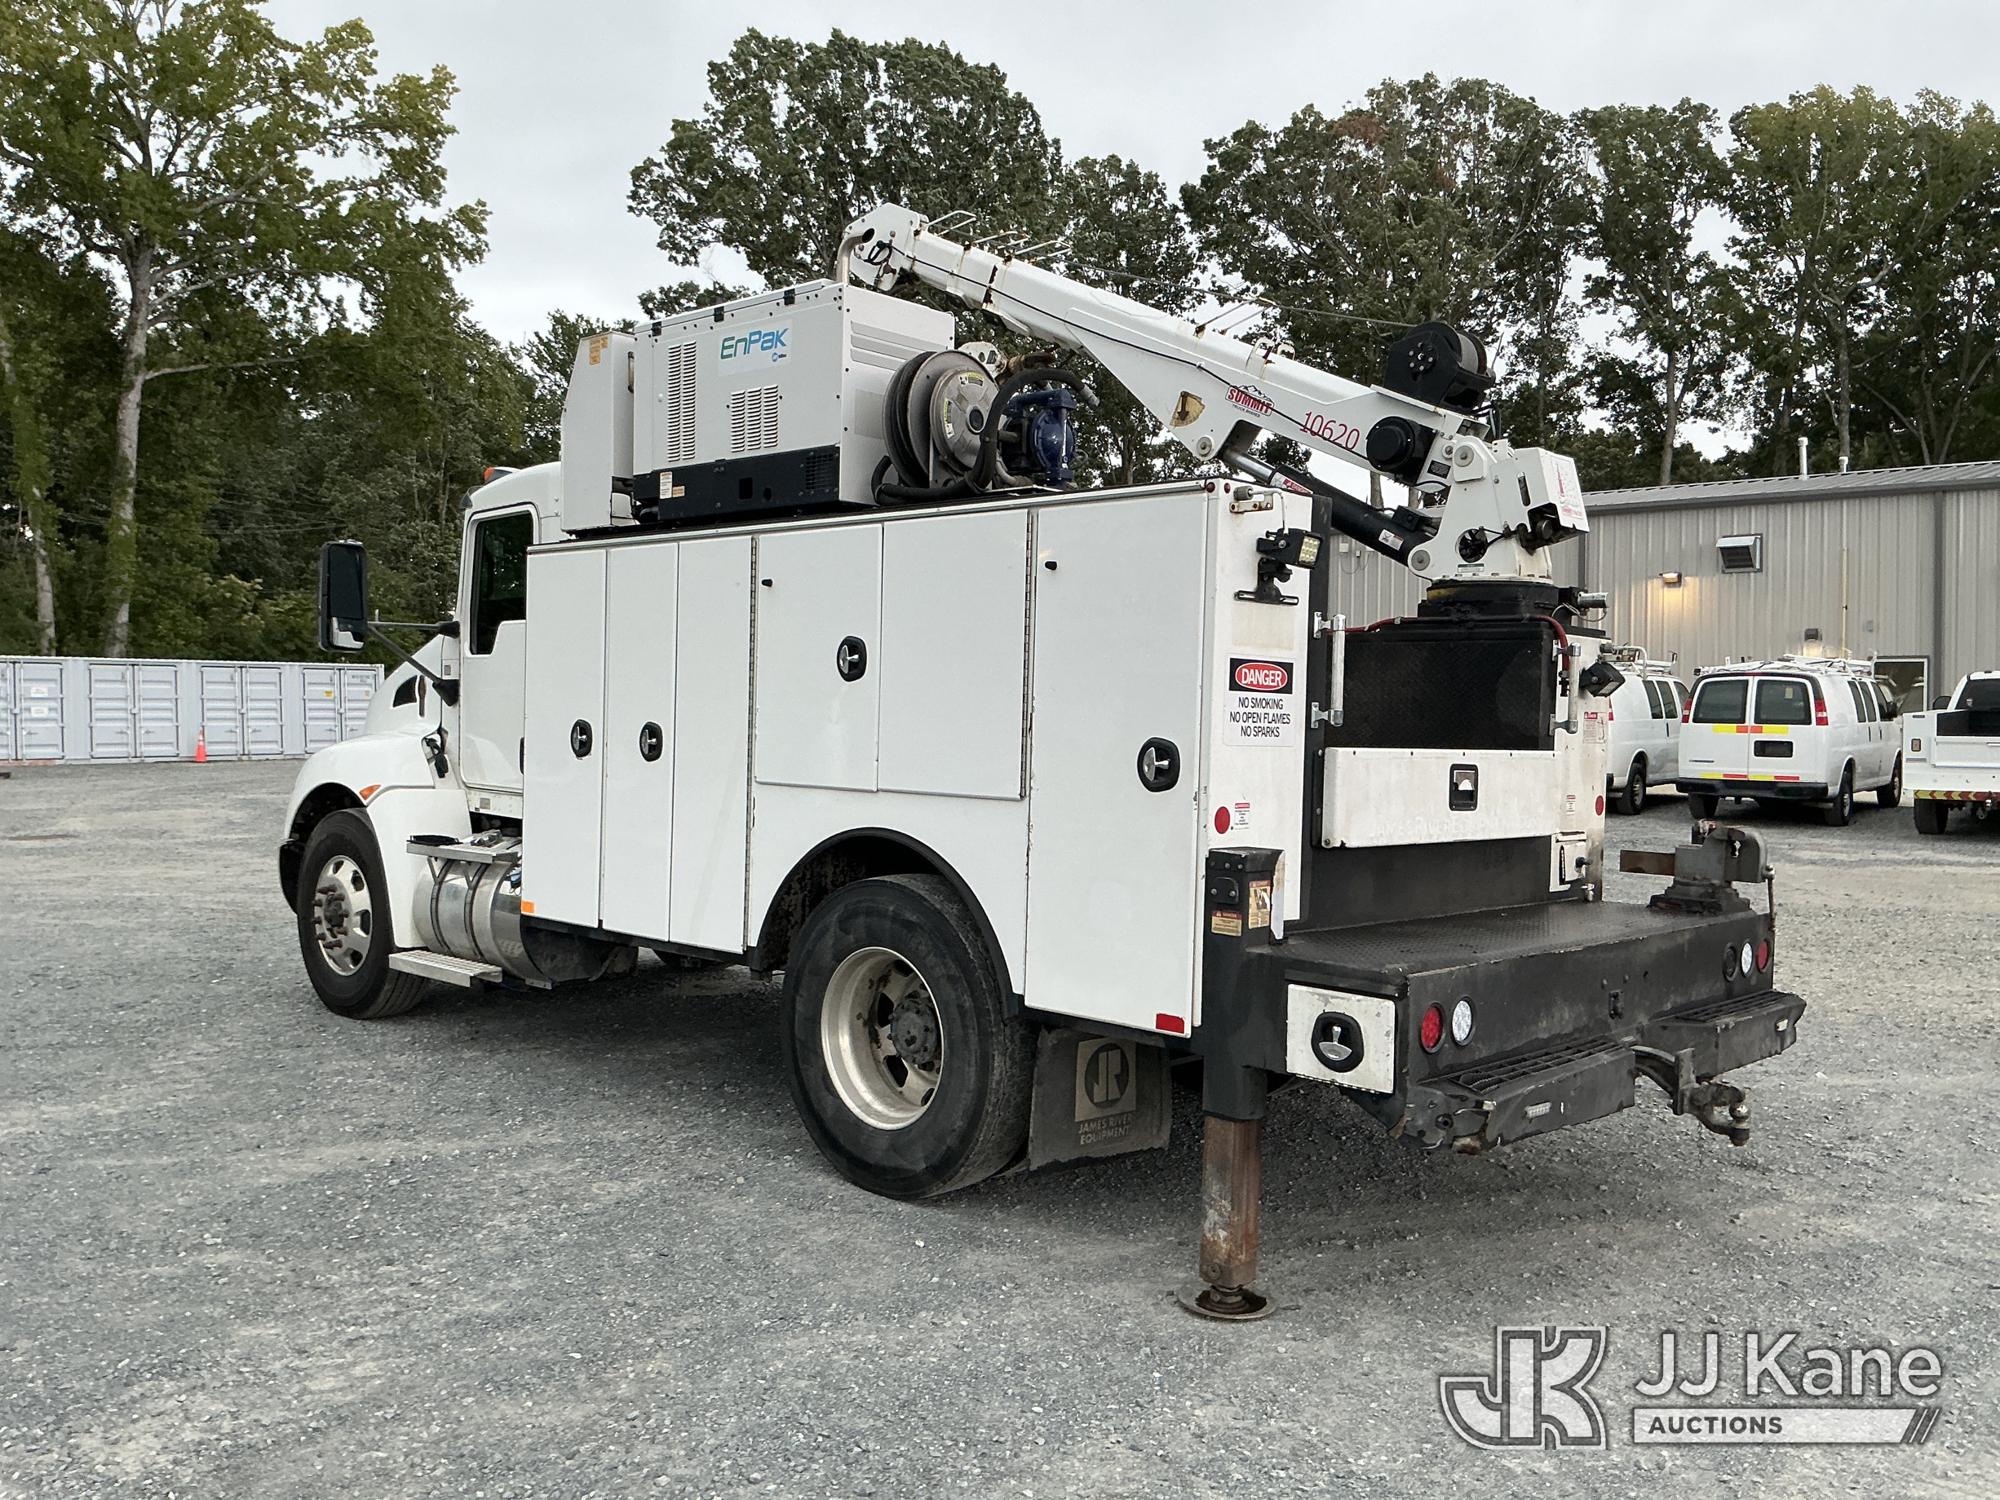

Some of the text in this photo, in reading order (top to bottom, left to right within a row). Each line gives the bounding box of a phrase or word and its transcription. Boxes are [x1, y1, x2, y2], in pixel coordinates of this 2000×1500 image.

[720, 328, 789, 360] EnPak
[1227, 387, 1273, 414] SUMMIT
[1300, 411, 1361, 450] 10620
[1241, 668, 1282, 687] DANGER
[1238, 696, 1284, 710] NO SMOKING
[1229, 711, 1291, 725] NO OPEN FLAMES
[1240, 725, 1280, 738] NO SPARKS
[1078, 1118, 1107, 1134] JAMES
